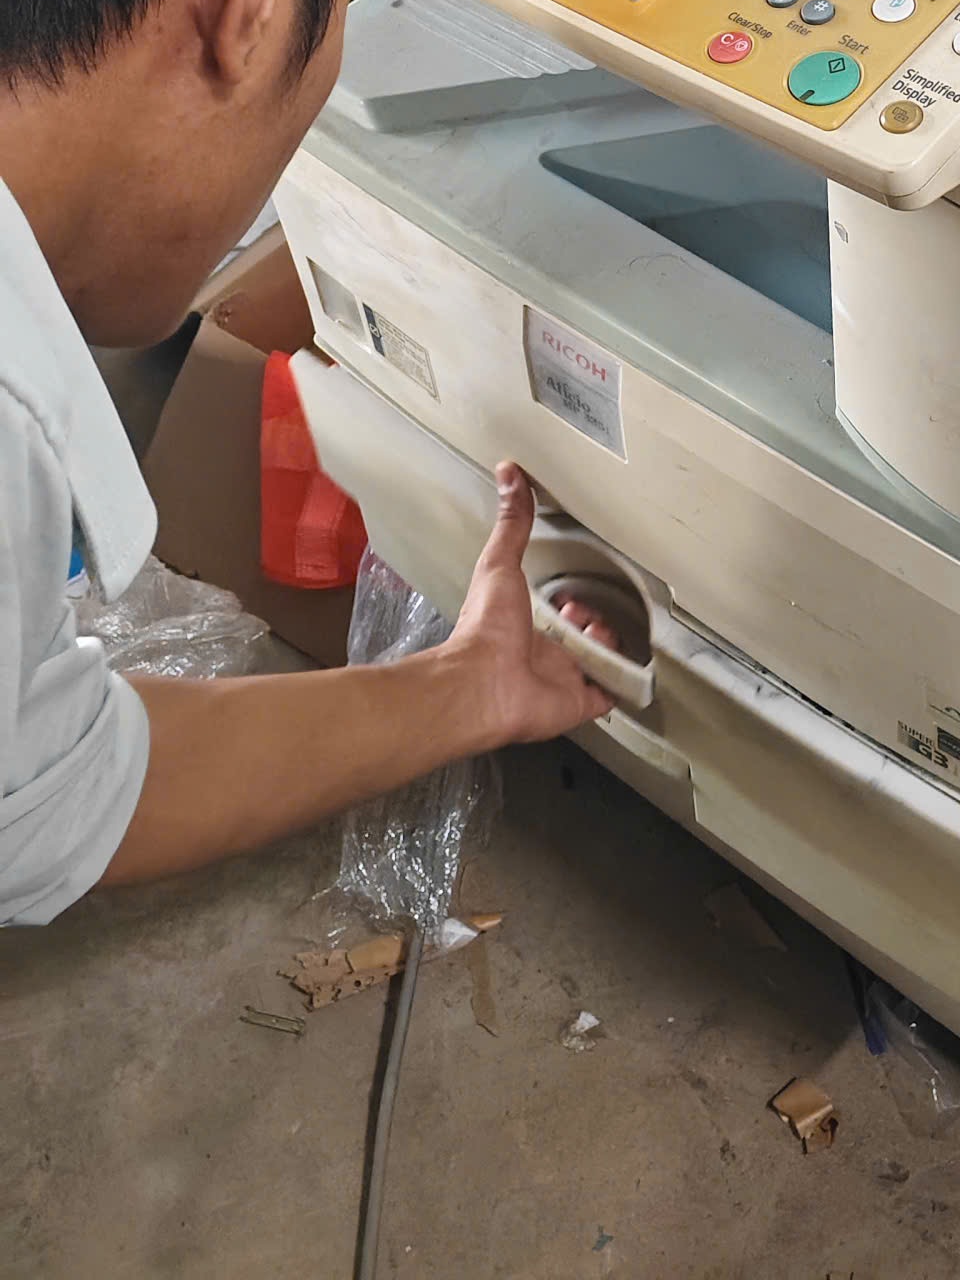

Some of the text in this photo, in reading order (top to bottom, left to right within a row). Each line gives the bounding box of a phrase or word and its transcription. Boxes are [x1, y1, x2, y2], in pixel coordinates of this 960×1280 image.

[727, 11, 773, 40] Clear/Stop
[786, 20, 813, 37] Enter
[838, 34, 870, 56] Start
[891, 80, 937, 108] Display
[543, 330, 608, 383] RICOH
[897, 720, 936, 747] SUPER
[917, 743, 949, 769] G3
